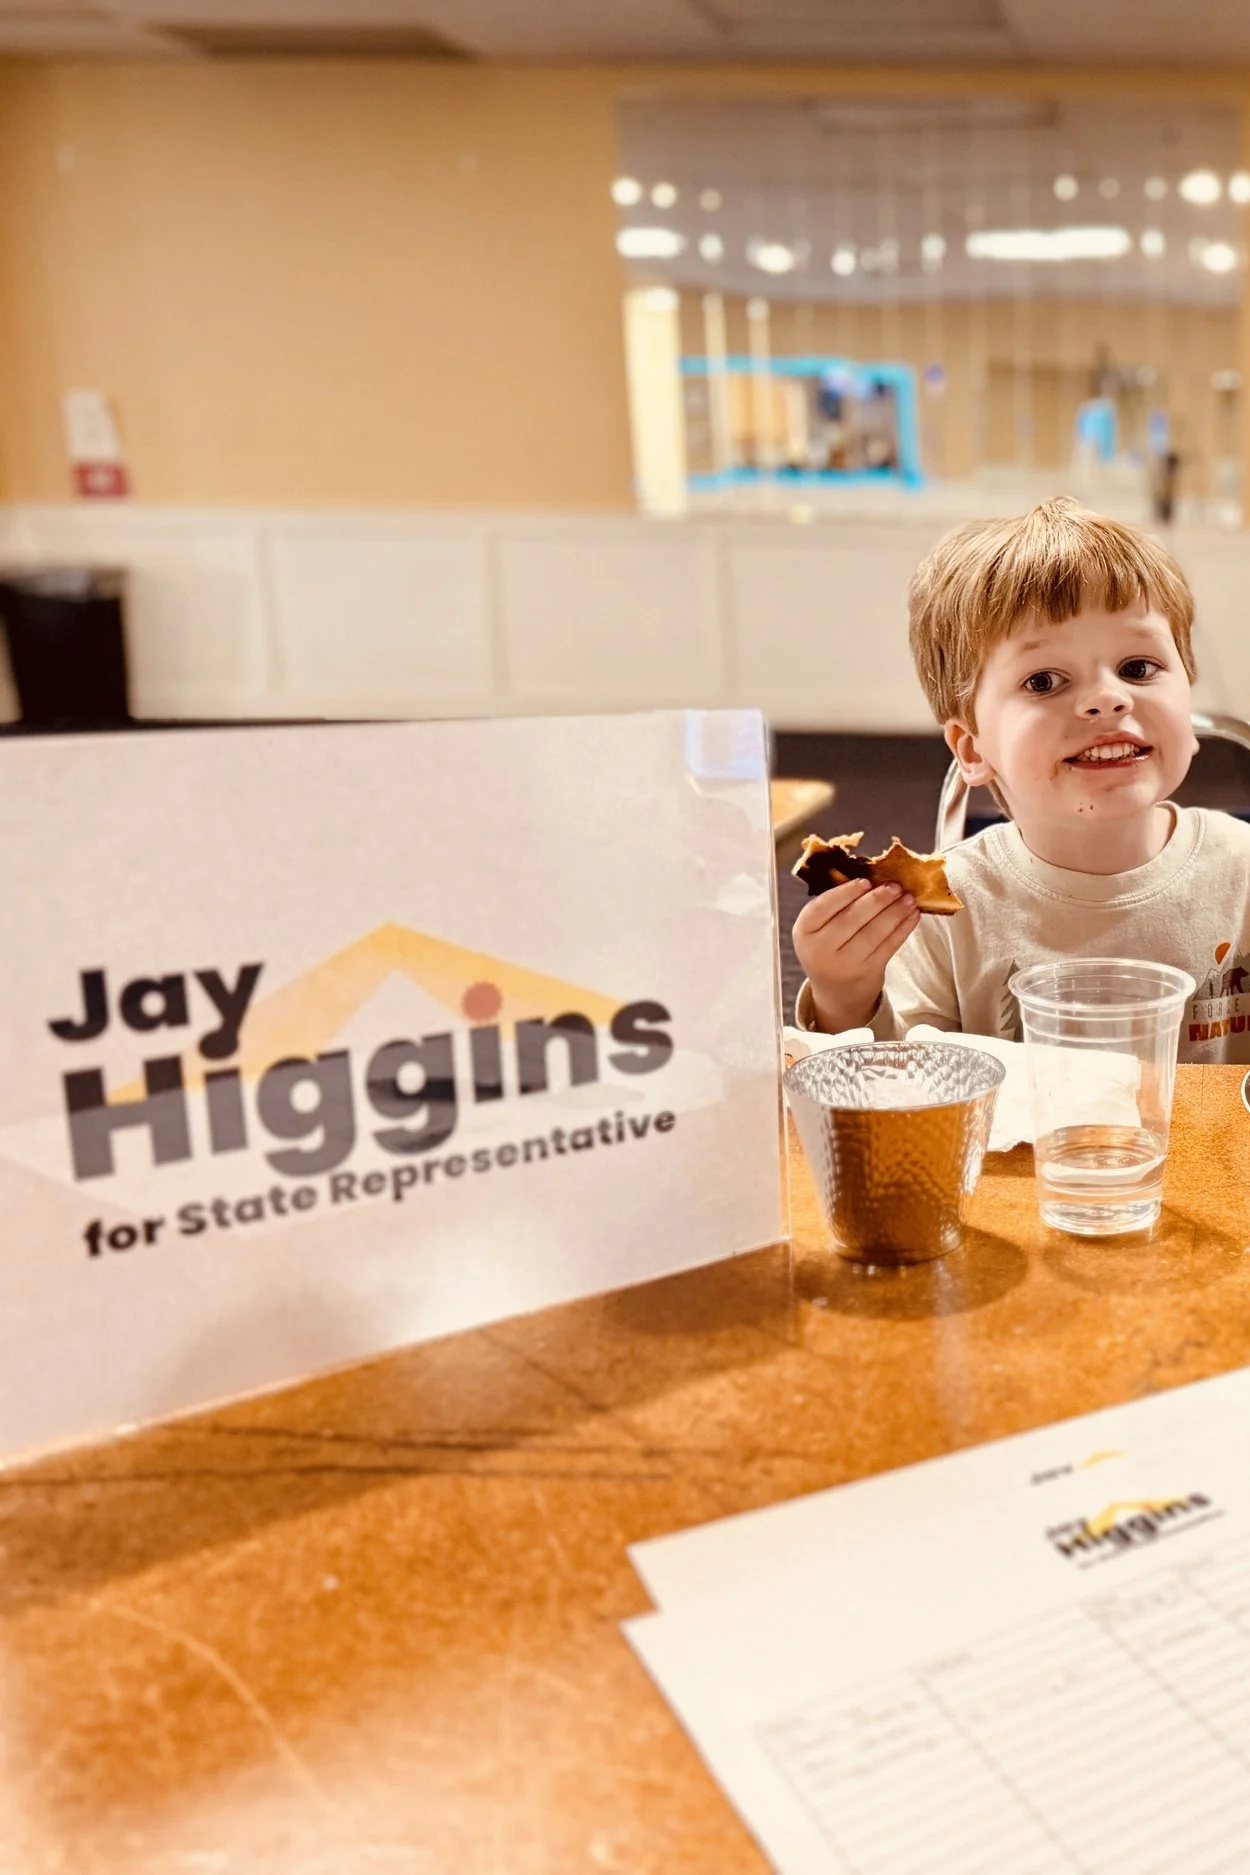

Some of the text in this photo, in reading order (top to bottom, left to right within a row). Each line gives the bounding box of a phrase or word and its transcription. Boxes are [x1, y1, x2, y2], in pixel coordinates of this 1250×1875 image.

[48, 961, 265, 1060] Jay
[1191, 997, 1241, 1021] FORE
[61, 982, 674, 1182] Higgins
[83, 1107, 677, 1257] for State Representative
